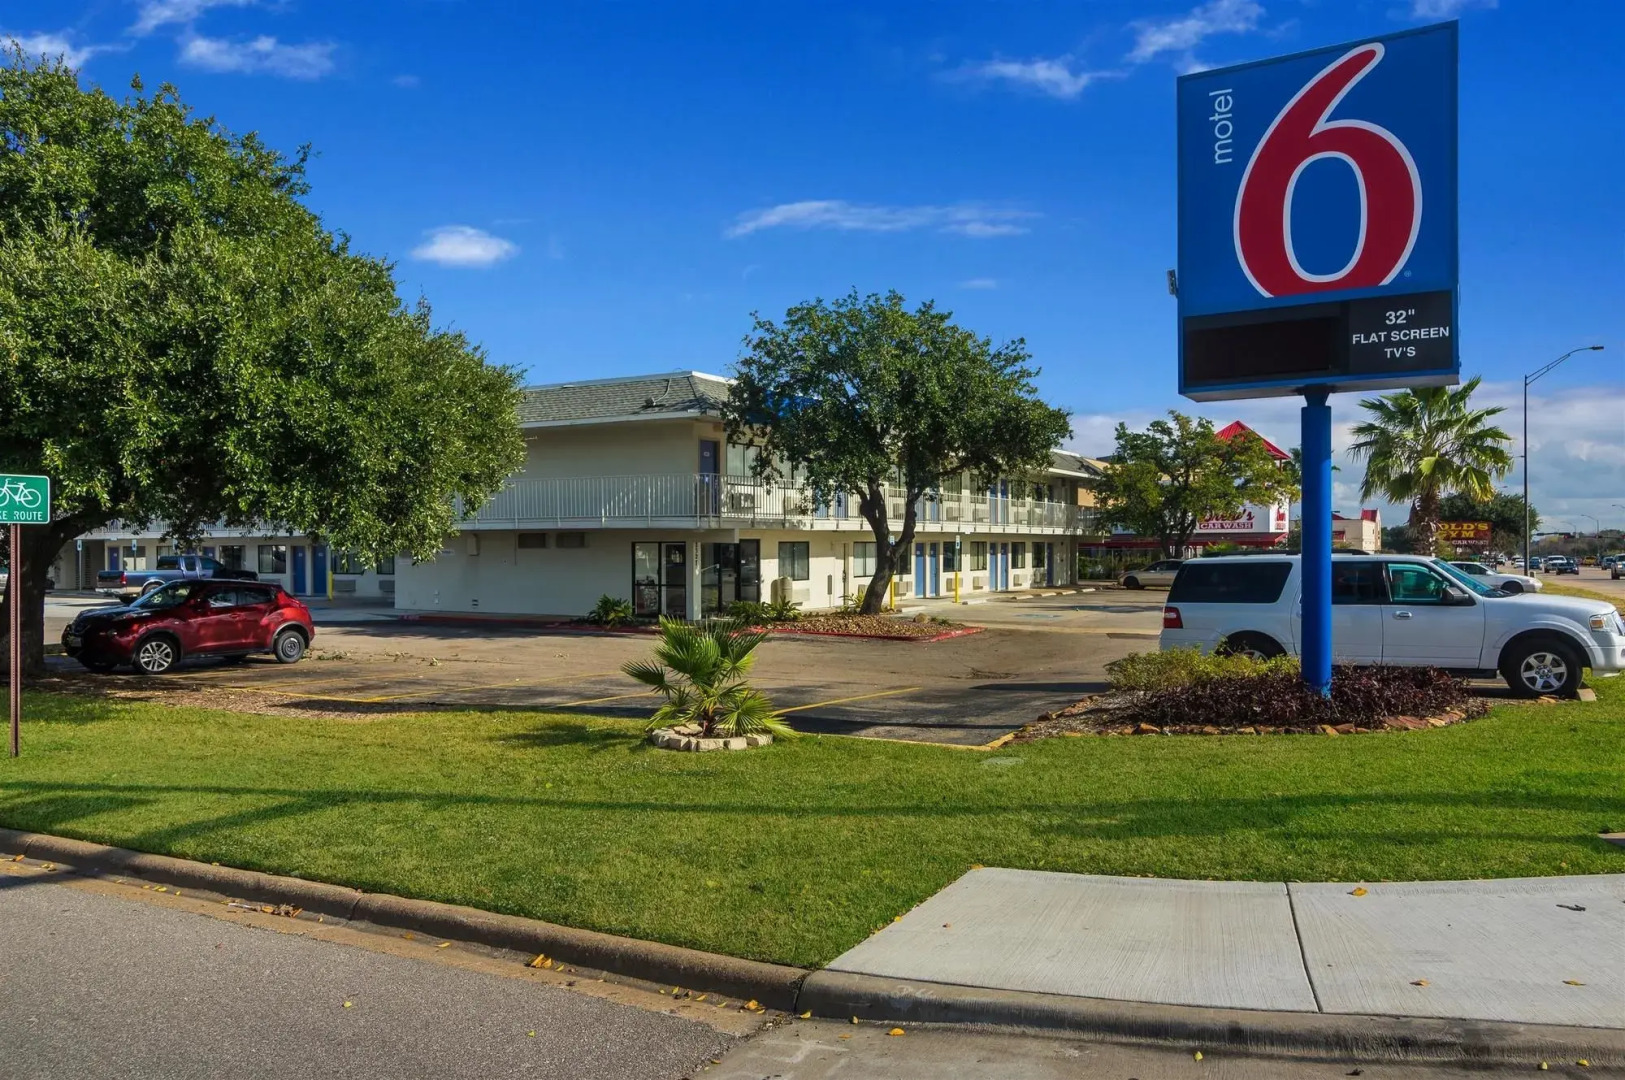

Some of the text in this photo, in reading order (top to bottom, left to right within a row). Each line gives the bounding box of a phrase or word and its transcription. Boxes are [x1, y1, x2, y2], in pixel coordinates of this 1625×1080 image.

[1209, 42, 1422, 298] motel 6
[1385, 308, 1415, 325] 32"
[1352, 326, 1449, 344] FLAT SCREEN
[1384, 346, 1416, 358] TV'S
[13, 510, 43, 521] ROUTE
